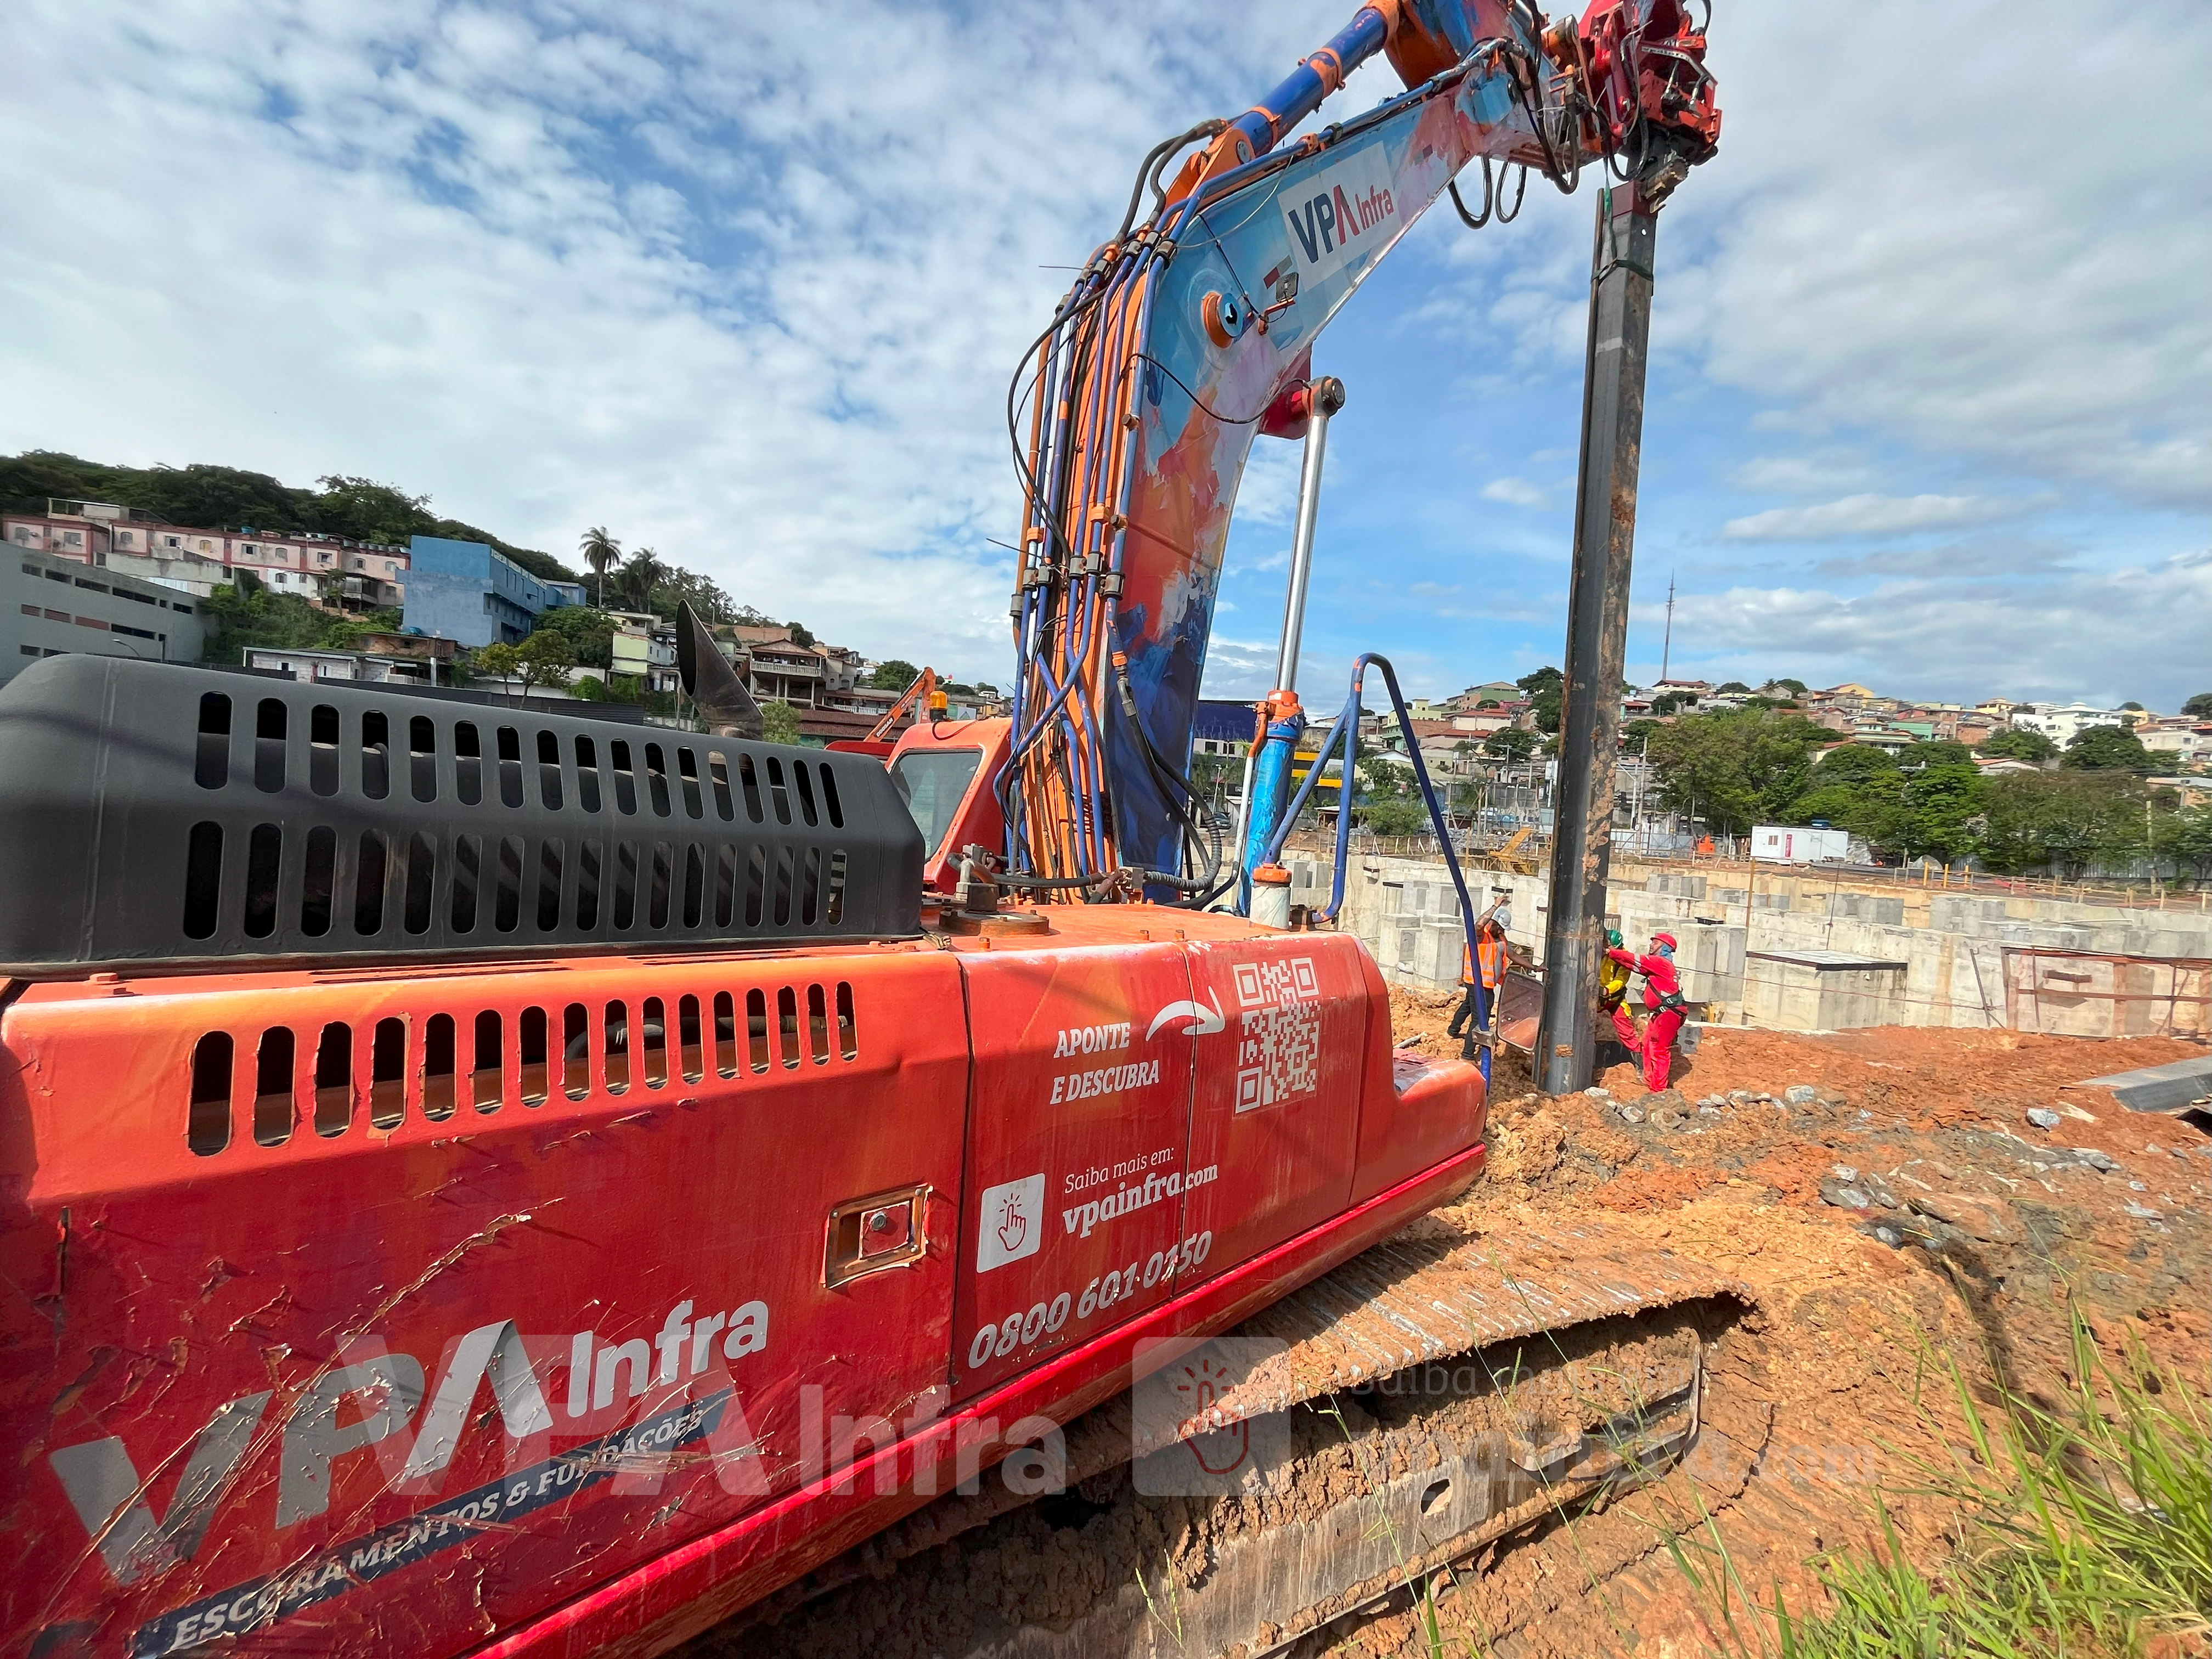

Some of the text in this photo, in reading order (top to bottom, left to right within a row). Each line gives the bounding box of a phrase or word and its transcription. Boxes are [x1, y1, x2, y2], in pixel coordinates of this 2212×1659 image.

[1288, 184, 1394, 264] VPA Infra
[876, 717, 893, 737] DOOSAN
[1053, 1022, 1131, 1058] APONTE
[1049, 1059, 1160, 1105] E DESCUBRA
[1062, 1164, 1218, 1238] vpainfra.com
[1064, 1147, 1175, 1194] Saiba mais em:
[968, 1229, 1212, 1369] 0800 601 0150
[48, 1299, 769, 1585] VPA Infra
[165, 1491, 500, 1655] ESCORAMENTOS
[501, 1480, 531, 1508] &
